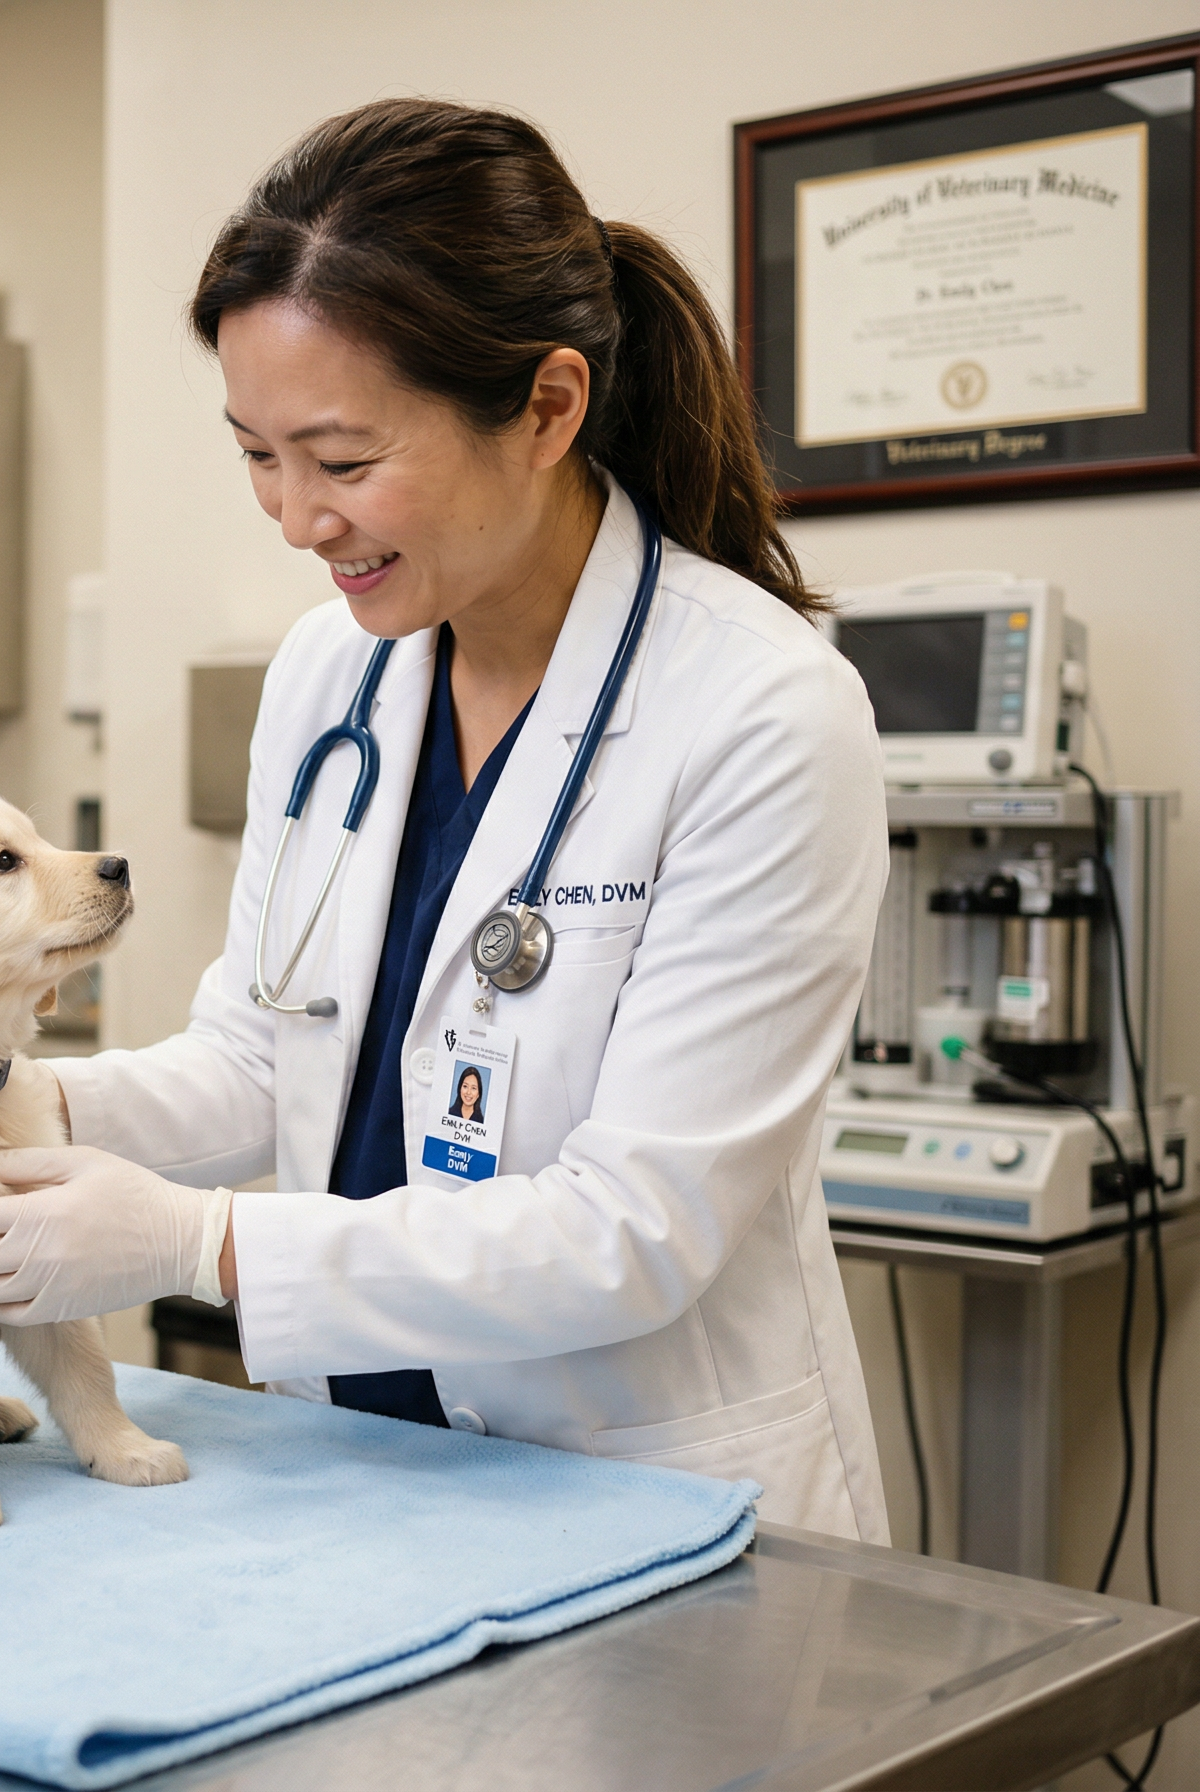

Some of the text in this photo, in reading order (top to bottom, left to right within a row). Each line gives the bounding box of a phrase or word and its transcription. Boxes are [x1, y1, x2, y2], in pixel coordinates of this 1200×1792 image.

[916, 180, 932, 207] of
[936, 173, 1030, 200] Veterinary
[1038, 167, 1119, 208] Medicine
[555, 885, 596, 906] CHEN,
[602, 881, 646, 902] DVM
[447, 1158, 468, 1173] DVM
